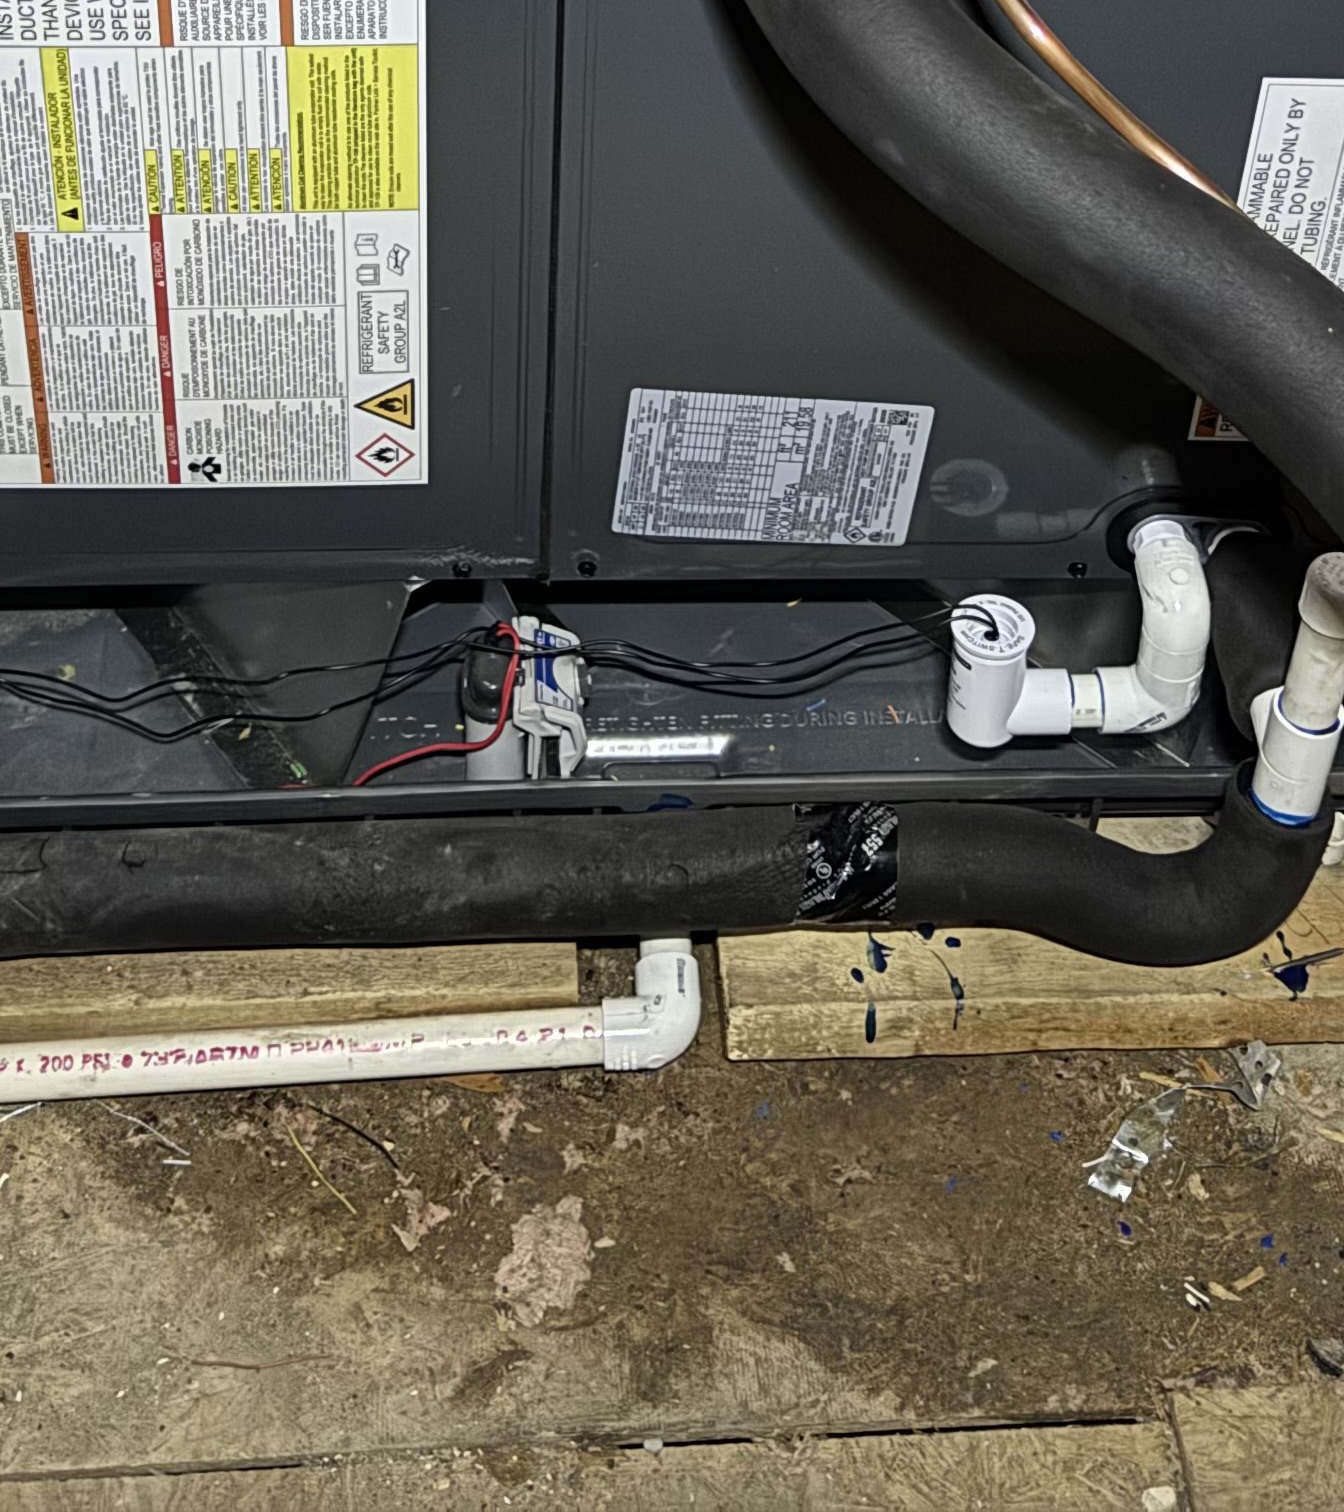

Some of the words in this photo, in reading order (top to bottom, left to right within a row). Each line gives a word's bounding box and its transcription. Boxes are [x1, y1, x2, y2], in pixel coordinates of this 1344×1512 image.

[87, 7, 106, 40] USE
[133, 8, 151, 40] SEE
[55, 48, 70, 85] UNIDAD)
[59, 87, 70, 99] LA
[1287, 98, 1306, 118] BY
[44, 91, 62, 148] INSTALADOR
[60, 101, 75, 152] FUNCIONAR
[65, 155, 76, 166] DE
[1277, 122, 1301, 164] ONLY
[51, 155, 67, 201] ATENCIÓN
[67, 168, 80, 199] (ANTES
[145, 164, 160, 204] CAUTION
[171, 153, 186, 204] ATTENTION
[198, 158, 214, 205] ATENCIÓN
[226, 160, 239, 200] CAUTION
[247, 153, 260, 200] ATTENTION
[269, 155, 283, 202] ATENCIÓN
[1293, 157, 1315, 188] NOT
[1287, 192, 1307, 214] DO
[1299, 198, 1327, 254] TUBING.
[393, 300, 407, 320] A2L
[359, 292, 374, 373] REFRIGERANT
[377, 311, 390, 353] SAFETY
[393, 323, 407, 363] GROUP
[783, 410, 798, 429] 211
[783, 482, 799, 509] AREA
[762, 497, 782, 540] MINIMUM
[775, 508, 792, 540] ROOM
[860, 832, 885, 858] 557
